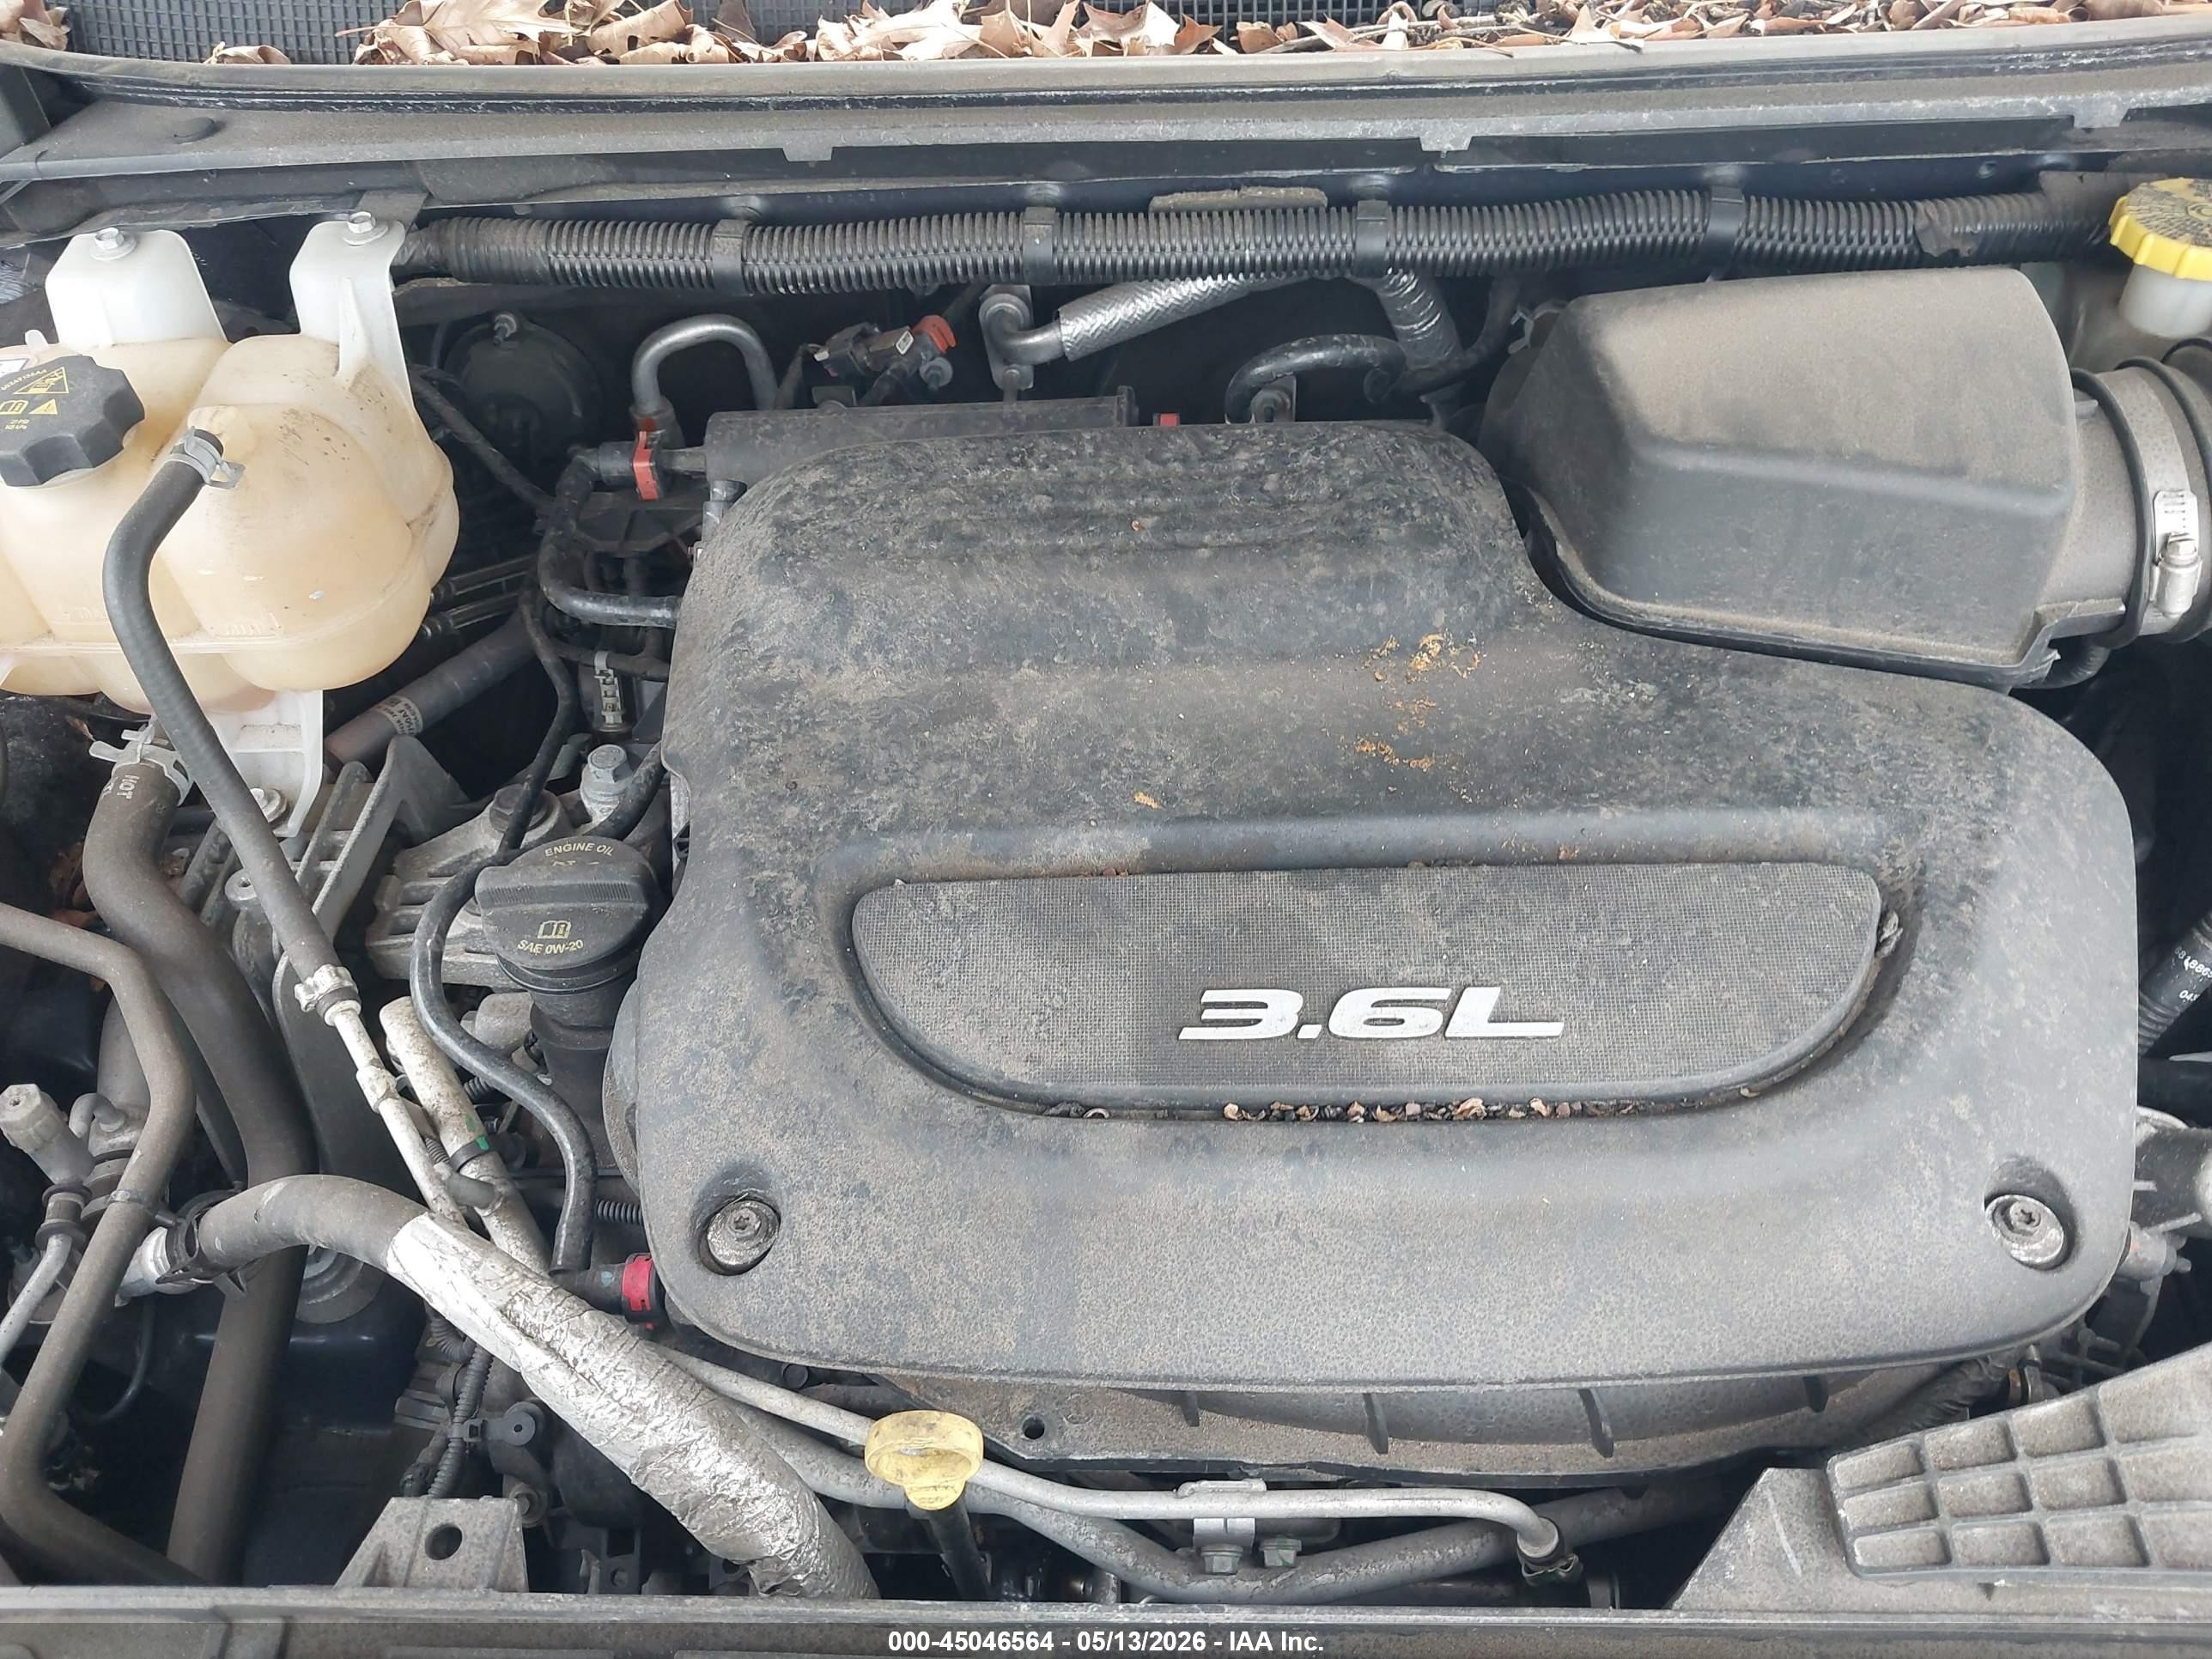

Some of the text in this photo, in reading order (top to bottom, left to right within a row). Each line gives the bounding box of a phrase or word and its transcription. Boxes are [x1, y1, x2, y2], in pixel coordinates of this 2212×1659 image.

[545, 842, 614, 857] ENGINE OIL
[517, 939, 584, 956] SAE 0W-20
[1178, 986, 1565, 1040] 3.6L
